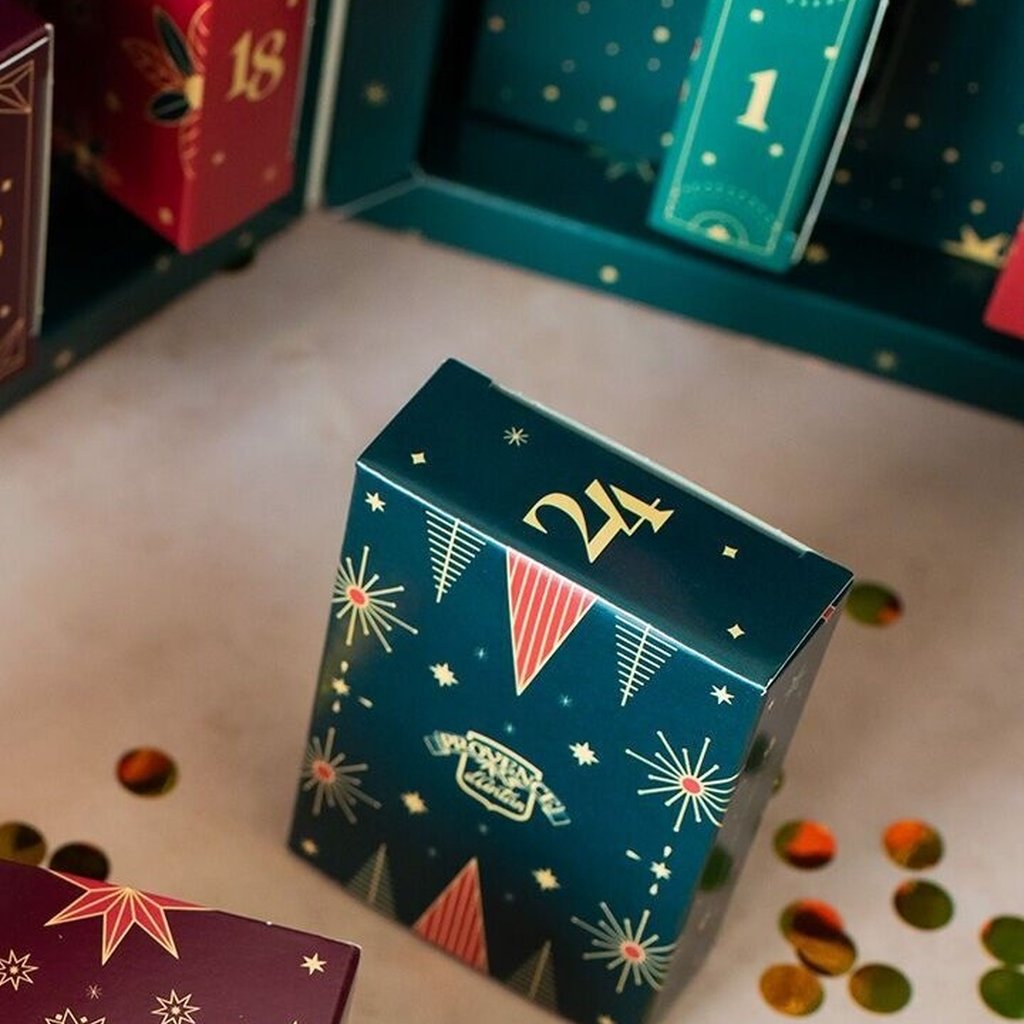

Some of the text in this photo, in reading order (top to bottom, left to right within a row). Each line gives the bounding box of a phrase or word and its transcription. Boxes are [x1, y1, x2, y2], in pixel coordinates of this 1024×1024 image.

[226, 29, 287, 102] 18
[736, 68, 778, 133] 1
[522, 478, 675, 564] 24
